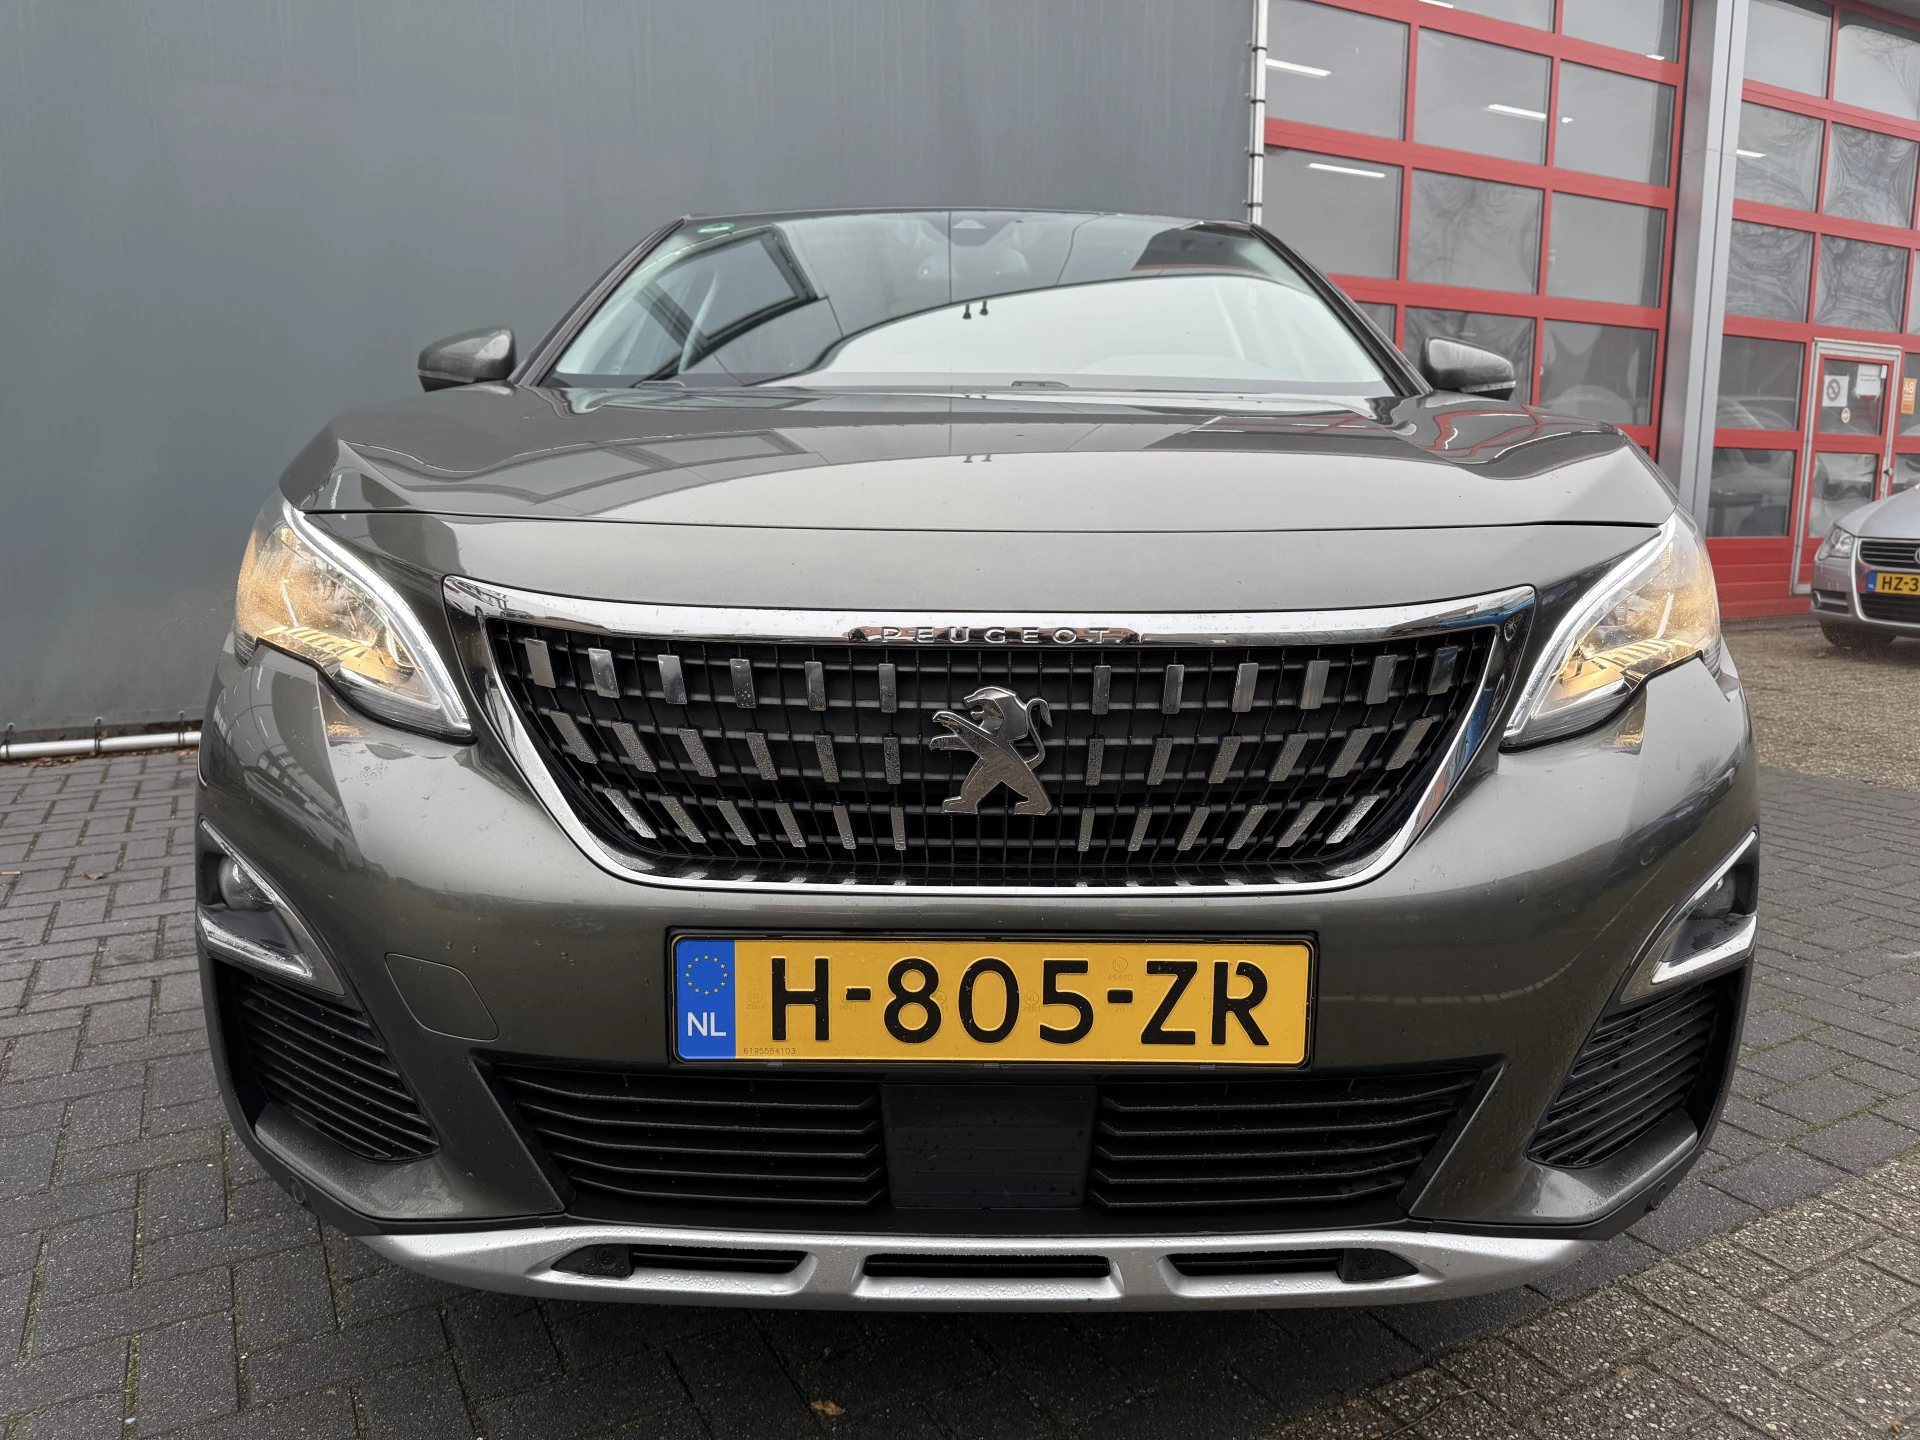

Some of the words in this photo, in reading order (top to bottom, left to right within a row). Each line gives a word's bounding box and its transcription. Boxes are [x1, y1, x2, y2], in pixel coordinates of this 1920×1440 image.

[881, 626, 1110, 643] PEUGEOT
[771, 957, 1270, 1045] H-805-ZR
[687, 1012, 727, 1037] NL
